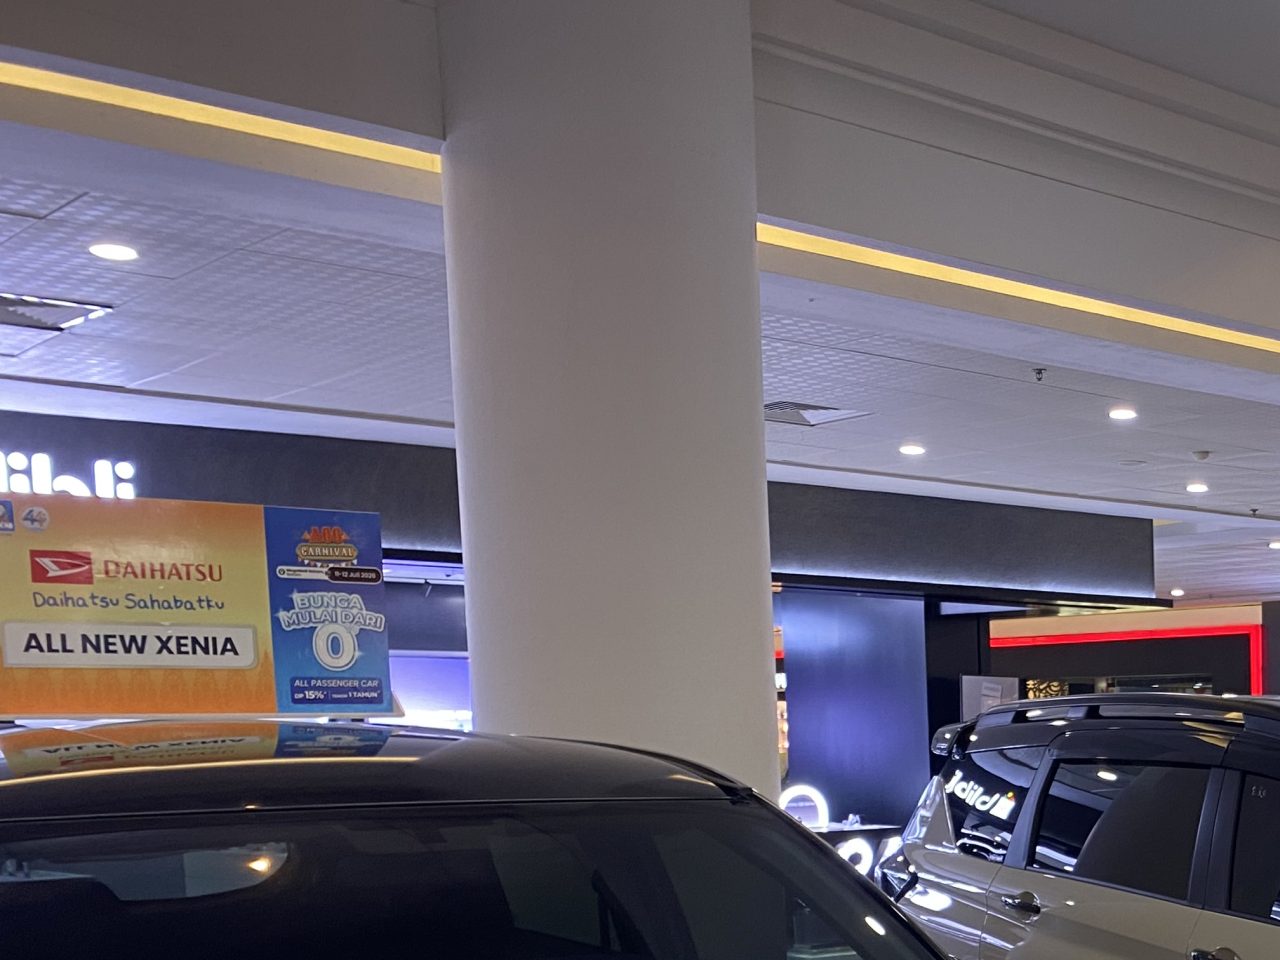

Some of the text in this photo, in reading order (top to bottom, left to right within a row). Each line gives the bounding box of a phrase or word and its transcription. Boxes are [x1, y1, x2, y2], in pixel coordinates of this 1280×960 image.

[301, 547, 354, 557] CARNIVAL
[103, 559, 223, 582] DAIHATSU
[33, 591, 225, 611] Daihatsu Sahabatku
[298, 594, 364, 610] BUNGA
[282, 610, 383, 629] MULAI DARI
[23, 632, 241, 656] ALL NEW XENIA
[313, 623, 358, 671] 0
[294, 679, 379, 688] ALL PASSENGER CAR
